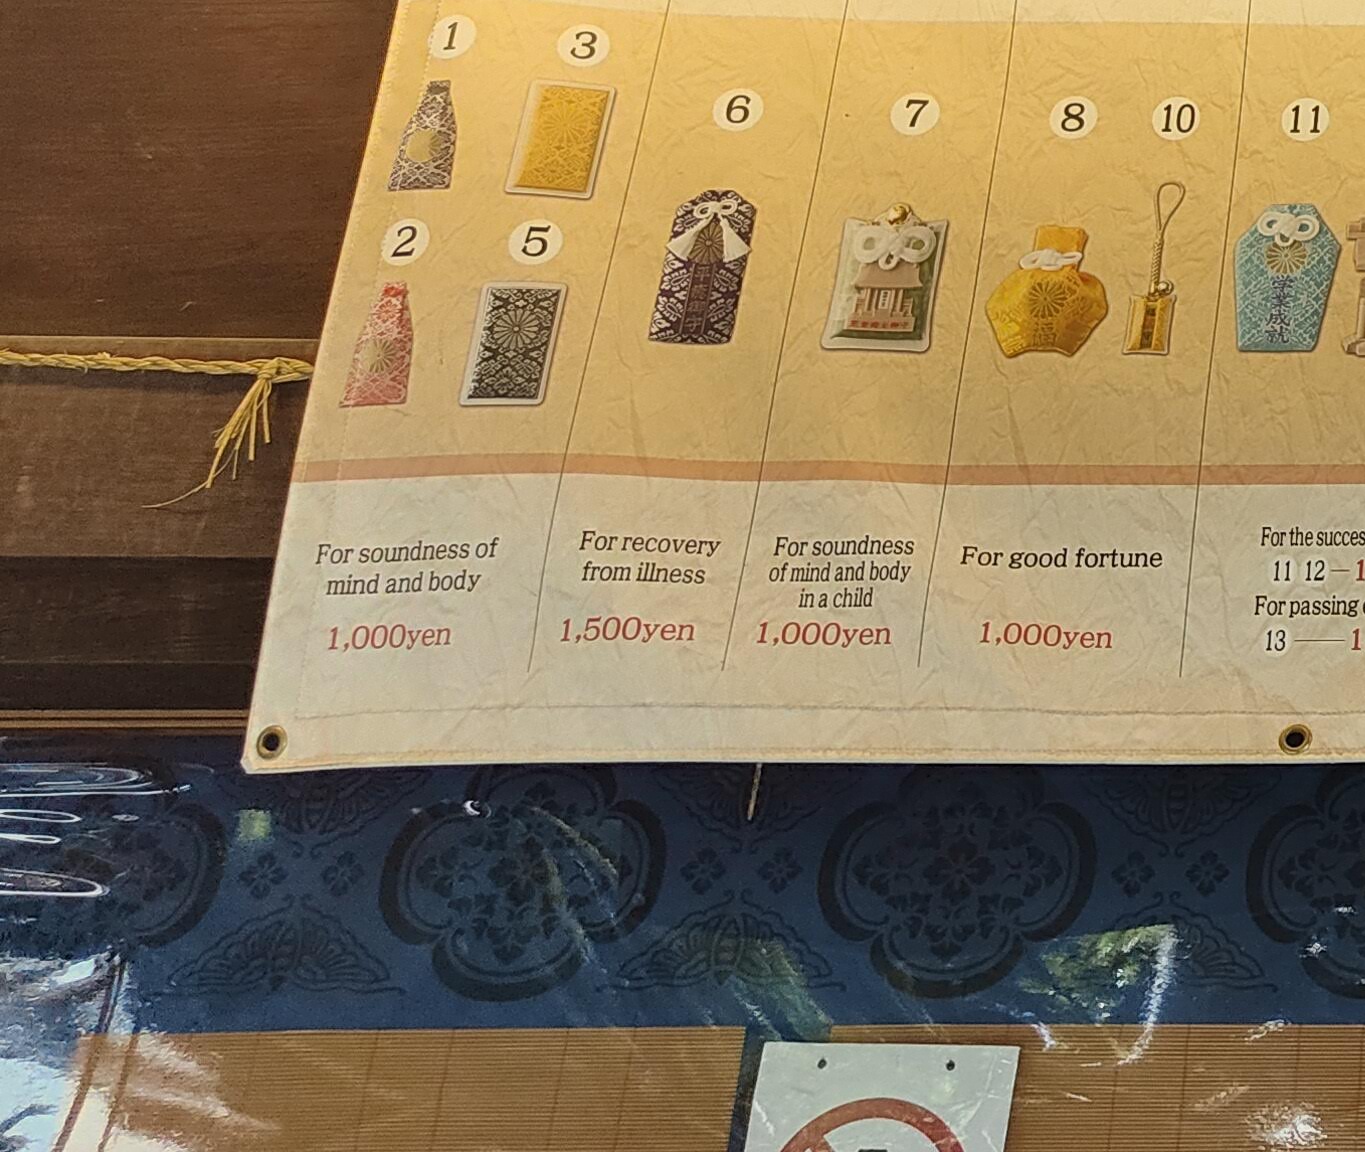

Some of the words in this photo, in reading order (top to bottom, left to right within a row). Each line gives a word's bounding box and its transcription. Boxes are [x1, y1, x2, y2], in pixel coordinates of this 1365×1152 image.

[442, 21, 458, 51] 1
[570, 31, 598, 60] 3
[725, 94, 751, 124] 6
[905, 99, 930, 128] 7
[1060, 102, 1085, 133] 8
[1161, 103, 1196, 134] 10
[1289, 104, 1321, 134] 11
[391, 225, 418, 258] 2
[521, 225, 551, 257] 5
[314, 543, 355, 565] For
[357, 539, 471, 564] soundness
[474, 536, 500, 559] of
[578, 530, 619, 552] For
[620, 536, 722, 558] recovery
[772, 536, 809, 558] For
[811, 534, 915, 557] soundness
[1260, 526, 1287, 548] For
[1288, 526, 1314, 547] the
[768, 561, 790, 583] of
[789, 561, 832, 583] mind
[833, 560, 866, 583] and
[868, 559, 912, 583] body
[959, 545, 1004, 567] For
[1007, 547, 1068, 570] good
[1074, 547, 1163, 569] fortune
[325, 572, 381, 596] mind
[384, 570, 424, 595] and
[427, 568, 483, 593] body
[581, 560, 632, 582] from
[635, 561, 706, 585] illness
[832, 586, 874, 609] child
[1254, 595, 1287, 617] For
[1288, 594, 1360, 619] passing
[327, 623, 451, 653] 1,000yen
[559, 615, 695, 644] 1,500yen
[756, 621, 892, 649] 1,000yen
[979, 621, 1113, 650] 1,000yen
